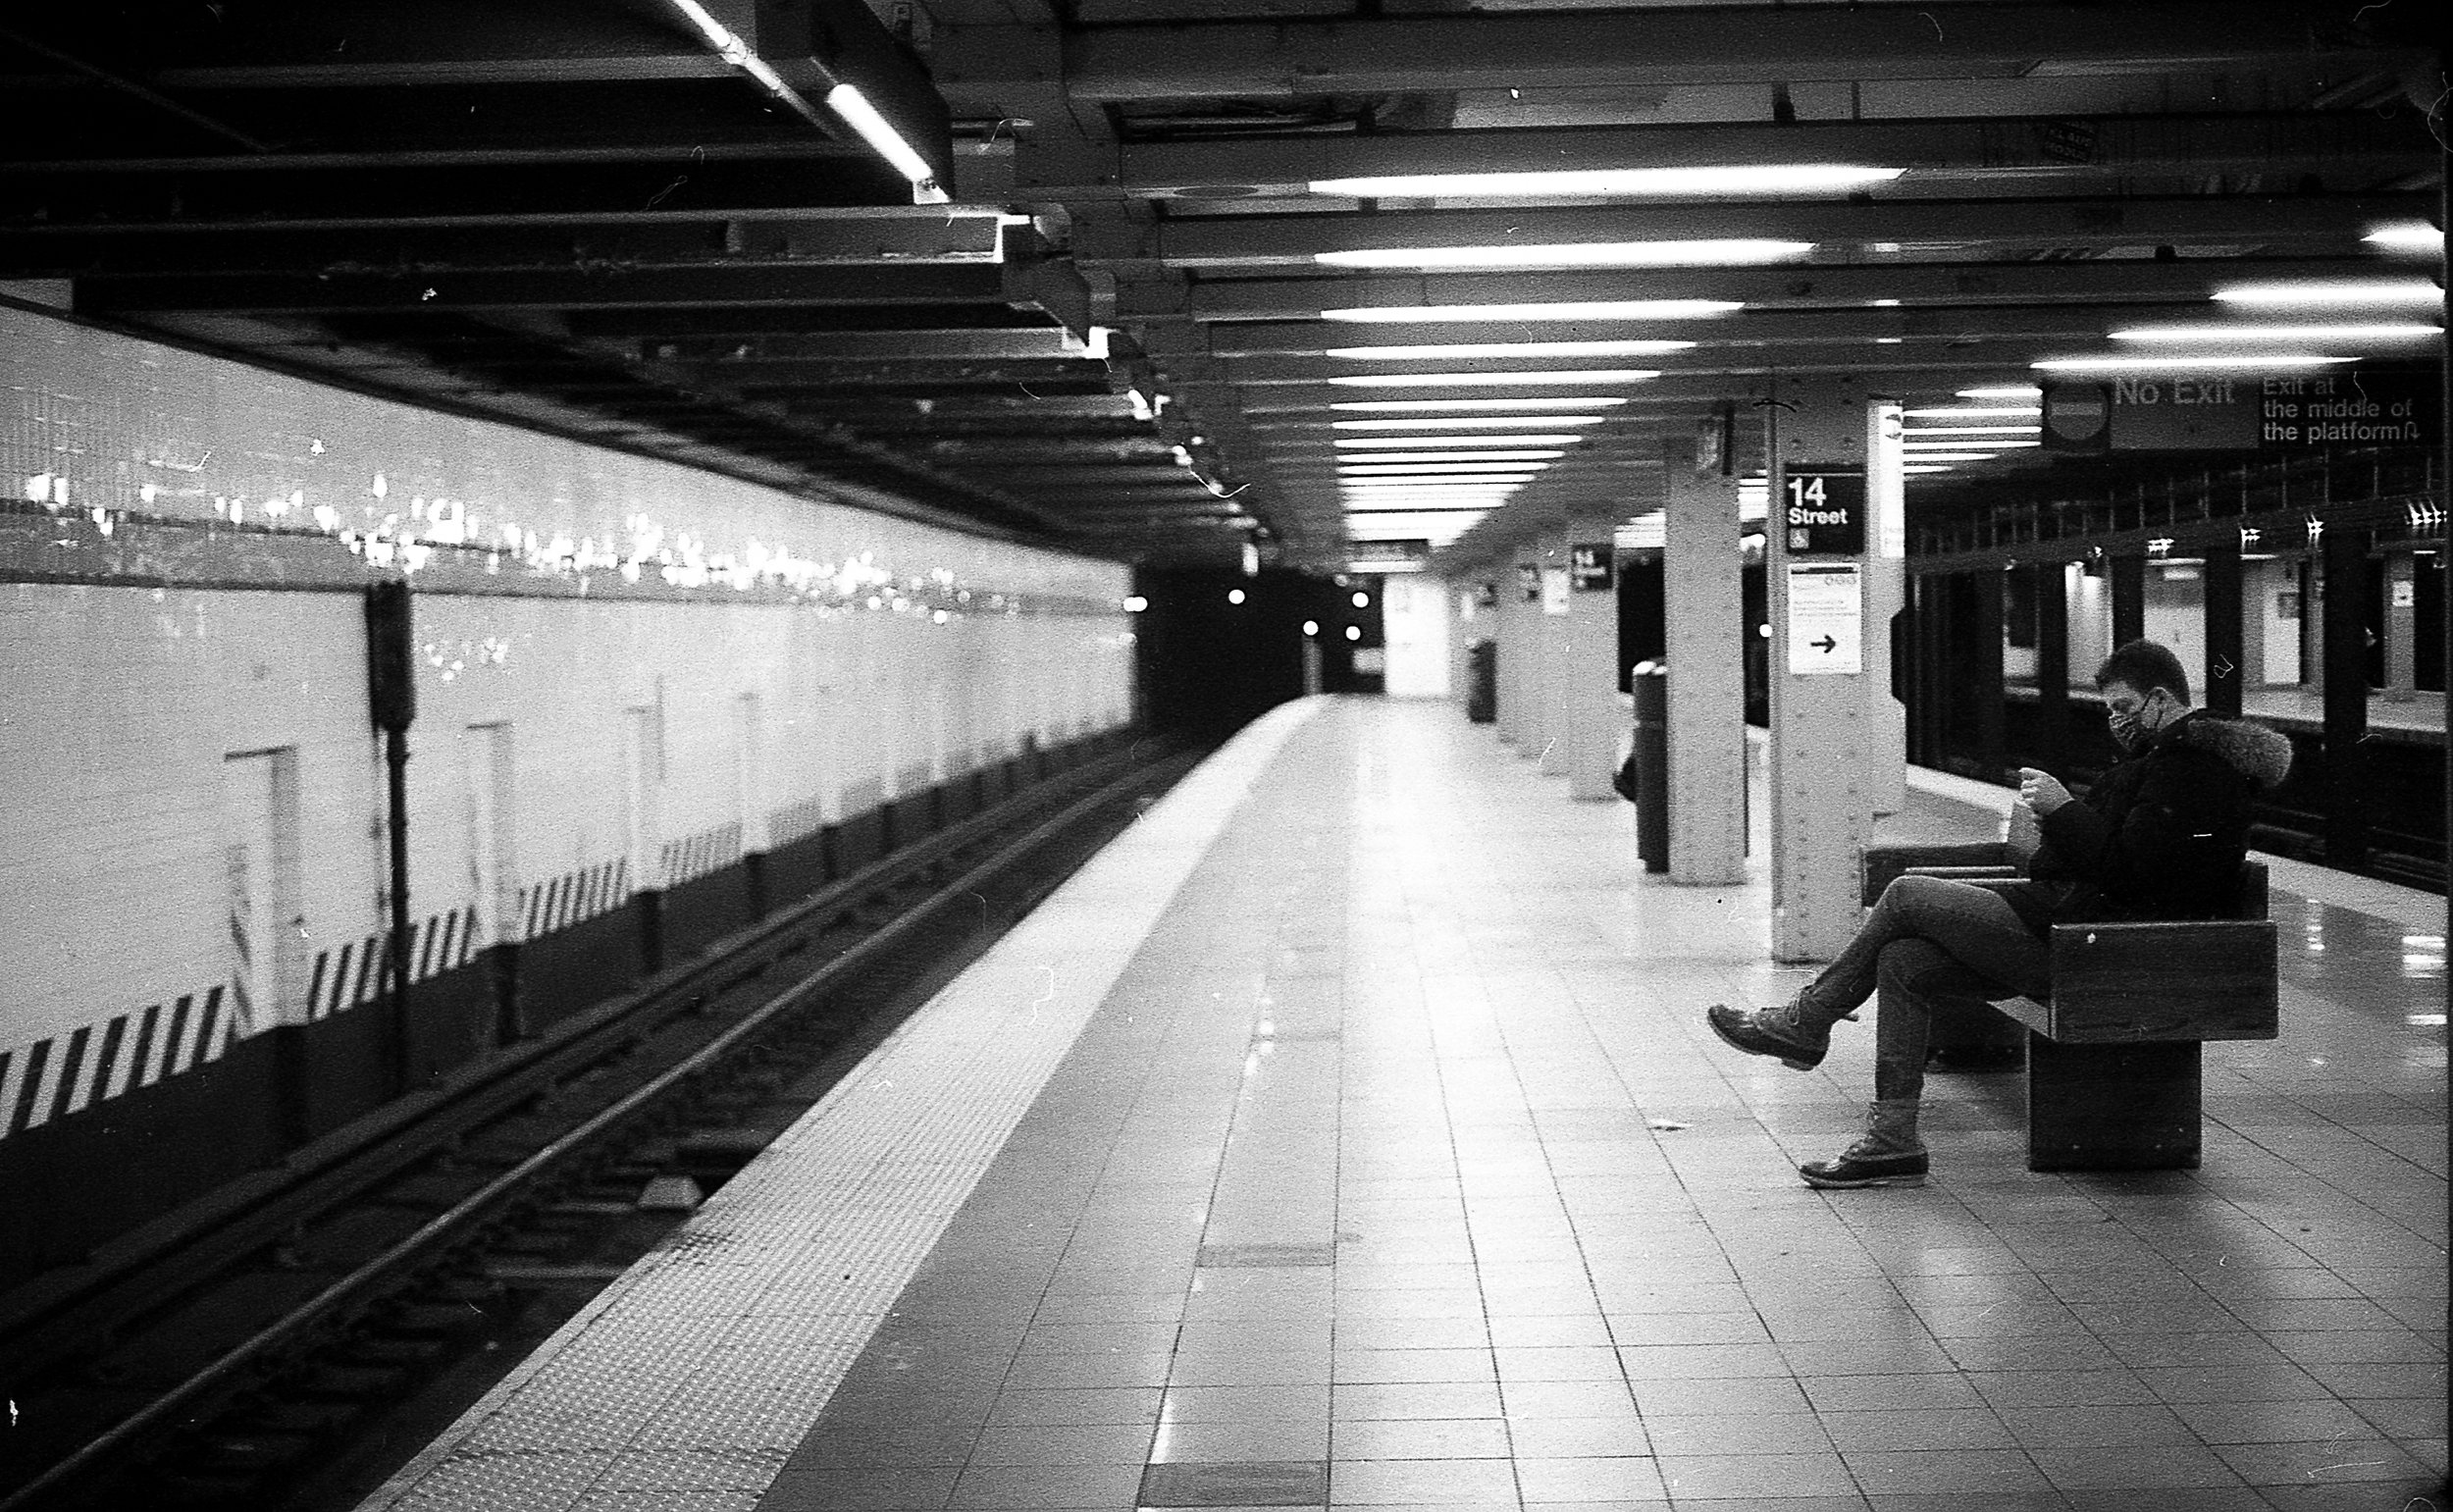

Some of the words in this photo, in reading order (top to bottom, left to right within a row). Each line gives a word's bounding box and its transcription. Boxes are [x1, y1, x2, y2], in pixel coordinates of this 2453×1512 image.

[2115, 380, 2158, 404] No
[2173, 379, 2235, 404] Exit
[2264, 378, 2306, 394] Exit
[2314, 378, 2335, 394] at
[2264, 399, 2298, 417] the
[2308, 399, 2379, 417] middle
[2390, 398, 2414, 417] of
[2264, 422, 2298, 440] the
[2308, 422, 2400, 444] platform
[1788, 477, 1827, 506] 14
[1788, 507, 1848, 524] Street
